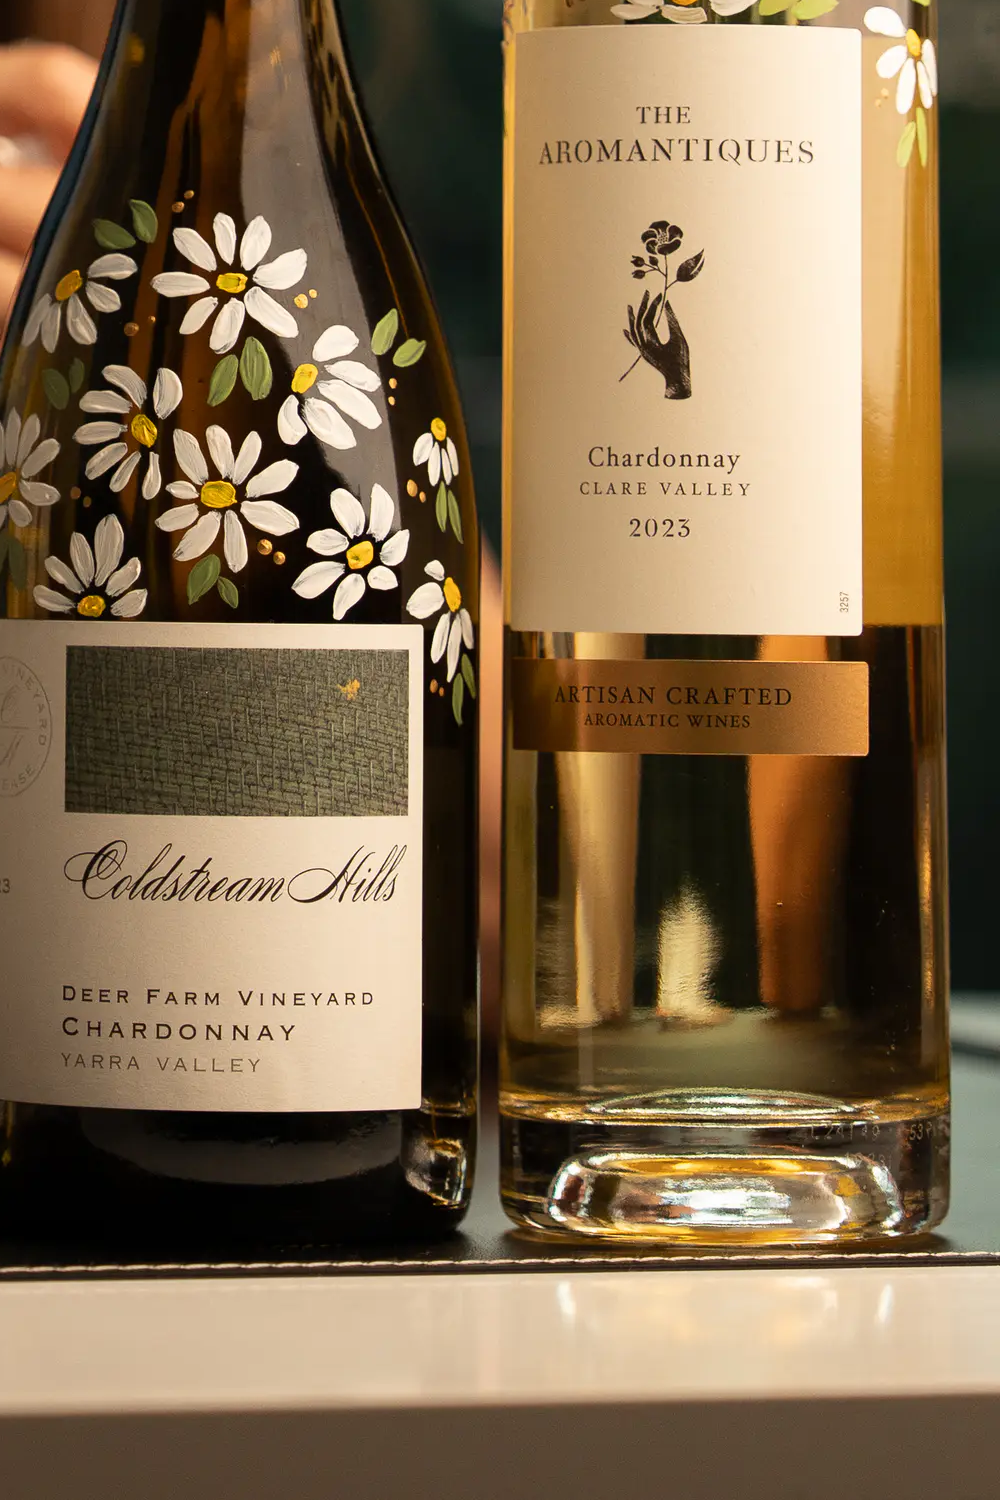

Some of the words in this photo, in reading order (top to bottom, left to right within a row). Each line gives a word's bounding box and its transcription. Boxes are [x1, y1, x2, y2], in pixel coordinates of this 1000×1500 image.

[635, 106, 691, 125] THE
[538, 138, 815, 167] AROMANTIQUES
[588, 446, 741, 474] Chardonnay
[579, 481, 648, 496] CLARE
[659, 481, 752, 497] VALLEY
[628, 518, 692, 539] 2023
[839, 591, 849, 613] 3257
[554, 685, 656, 705] ARTISAN
[665, 686, 793, 706] CRAFTED
[583, 712, 680, 729] AROMATIC
[688, 713, 752, 729] WINES
[63, 839, 284, 904] Coldstream
[288, 844, 408, 904] Hills
[62, 985, 130, 1004] DEER
[146, 988, 221, 1006] FARM
[237, 989, 375, 1007] VINEYARD
[62, 1016, 297, 1042] CHARDONNAY
[61, 1051, 141, 1071] YARRA
[156, 1055, 262, 1073] VALLEY
